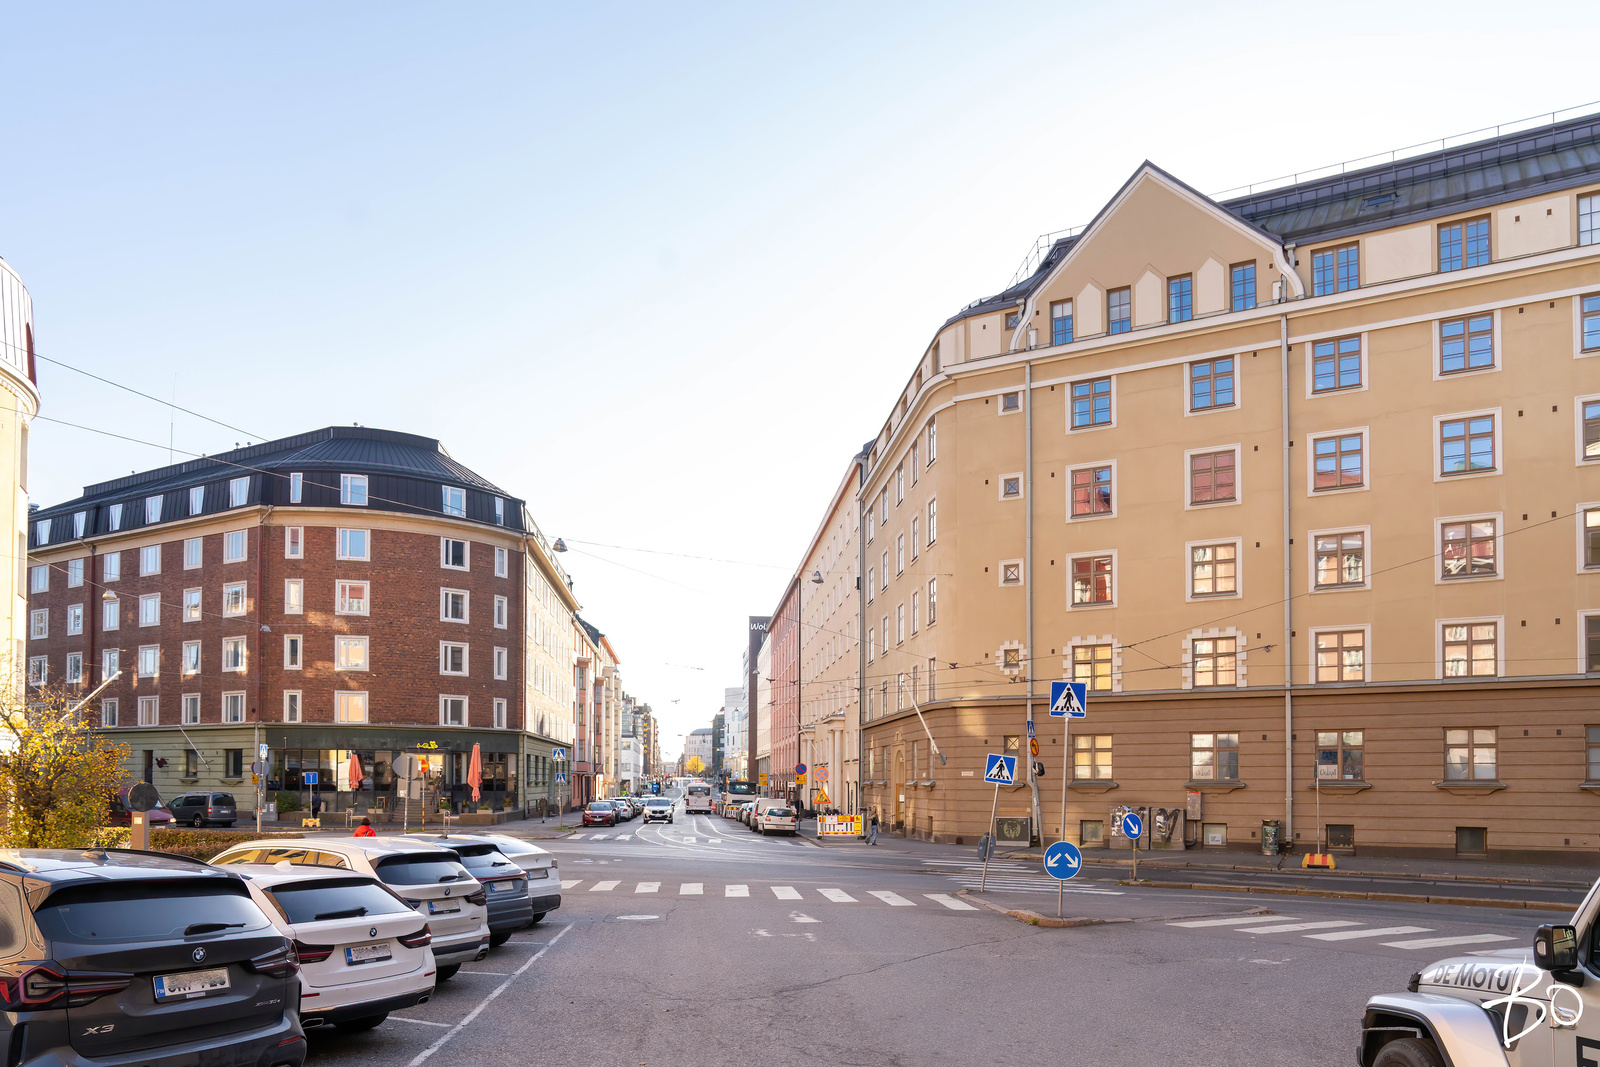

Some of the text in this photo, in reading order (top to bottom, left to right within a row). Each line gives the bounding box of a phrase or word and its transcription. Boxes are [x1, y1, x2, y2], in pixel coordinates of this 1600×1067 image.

[751, 622, 768, 631] Wol
[1433, 963, 1512, 992] DE MOTU
[81, 1024, 115, 1037] X3
